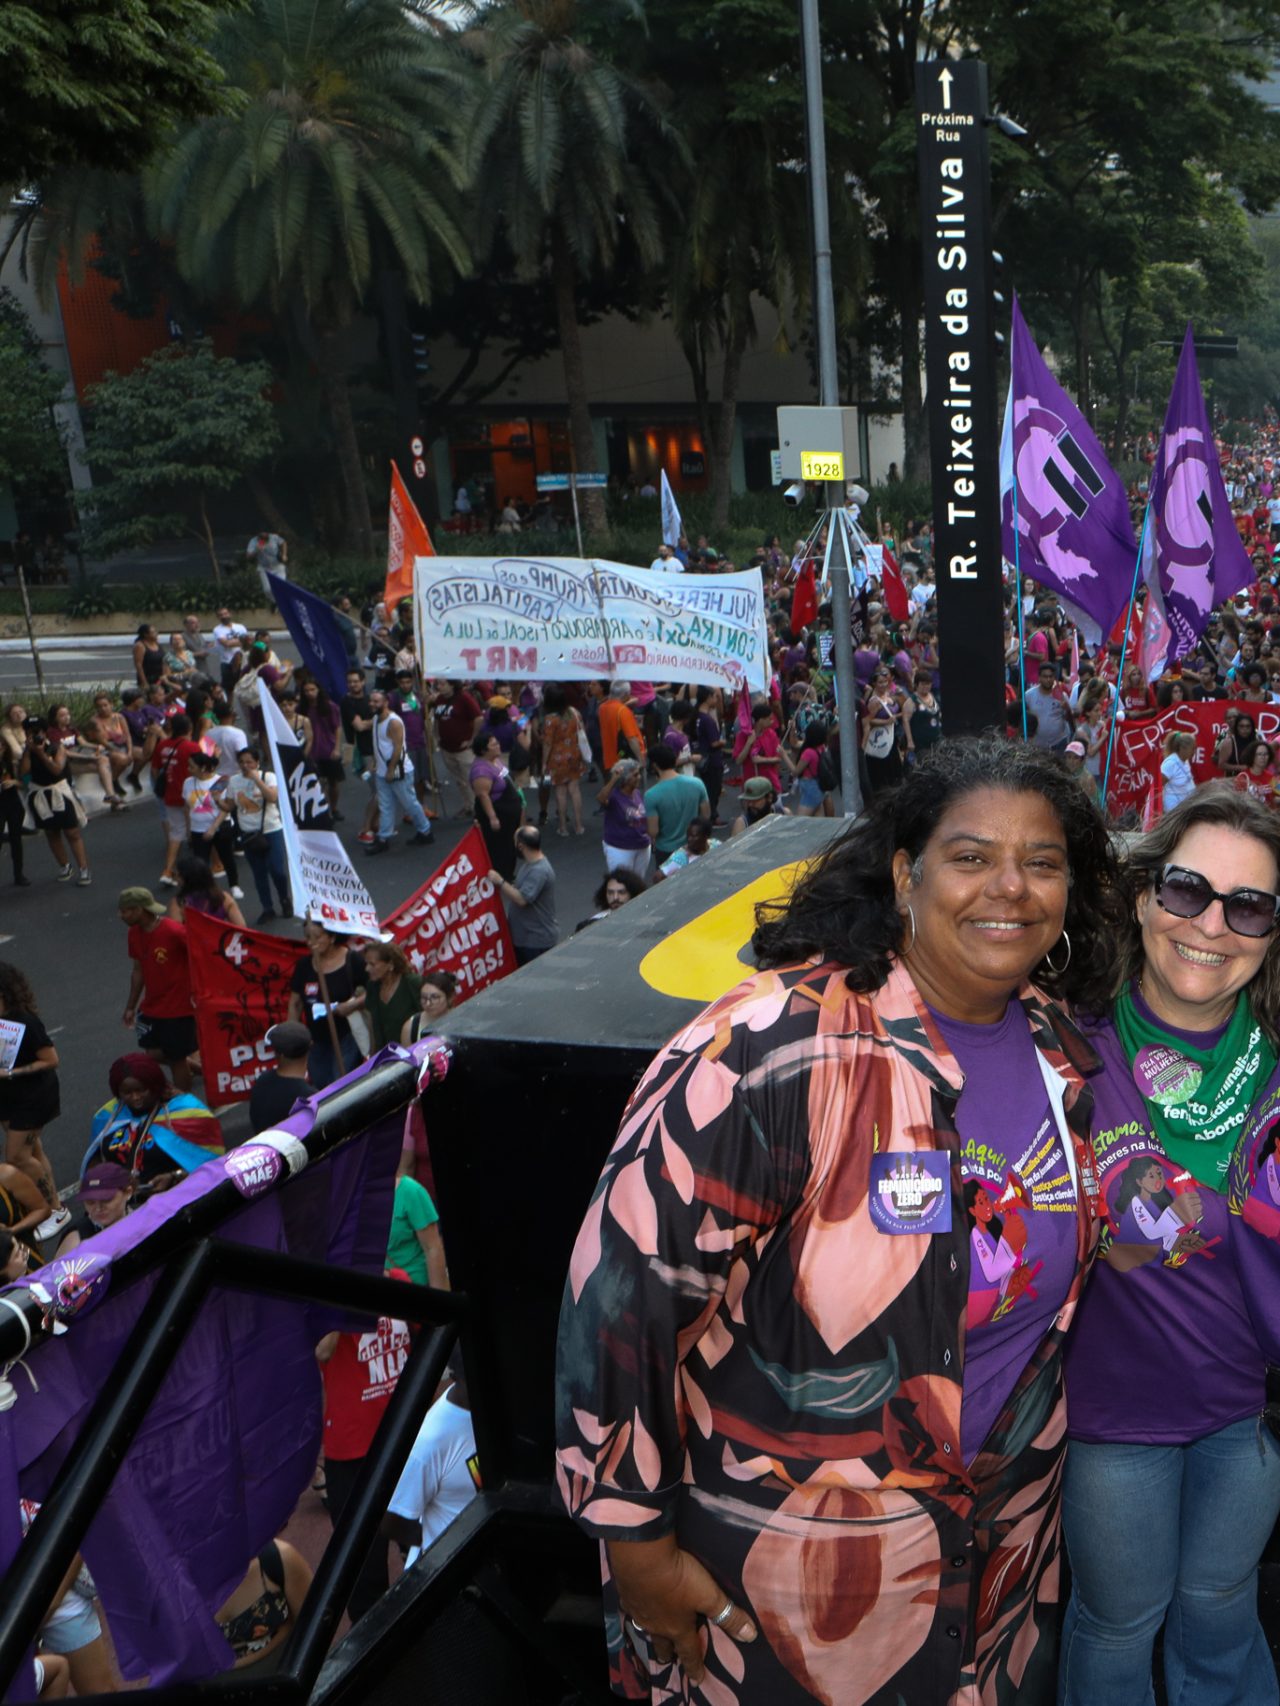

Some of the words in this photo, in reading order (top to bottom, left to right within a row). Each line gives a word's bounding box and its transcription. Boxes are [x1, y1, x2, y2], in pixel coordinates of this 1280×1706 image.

[921, 112, 974, 127] Próxima
[936, 130, 960, 142] Rua
[937, 157, 966, 271] Silva
[940, 287, 968, 336] da
[943, 350, 977, 524] Teixeira
[806, 463, 840, 477] 1928
[949, 541, 978, 580] R.
[352, 892, 373, 907] PAU
[225, 931, 249, 966] 4
[410, 911, 500, 975] tadura
[454, 938, 504, 994] rias!
[229, 1041, 276, 1068] PC
[1139, 1057, 1154, 1072] PELA
[1143, 1053, 1185, 1080] MULHERES
[1092, 1120, 1146, 1157] stamos
[1096, 1145, 1130, 1178] ulheres
[1131, 1140, 1146, 1151] na
[878, 1177, 943, 1194] FEMINICÍDIO
[1052, 1172, 1071, 1187] reprod
[896, 1192, 923, 1207] ZERO
[1032, 1192, 1054, 1204] Justiça
[1032, 1201, 1049, 1212] Sem
[1049, 1202, 1072, 1213] anistia
